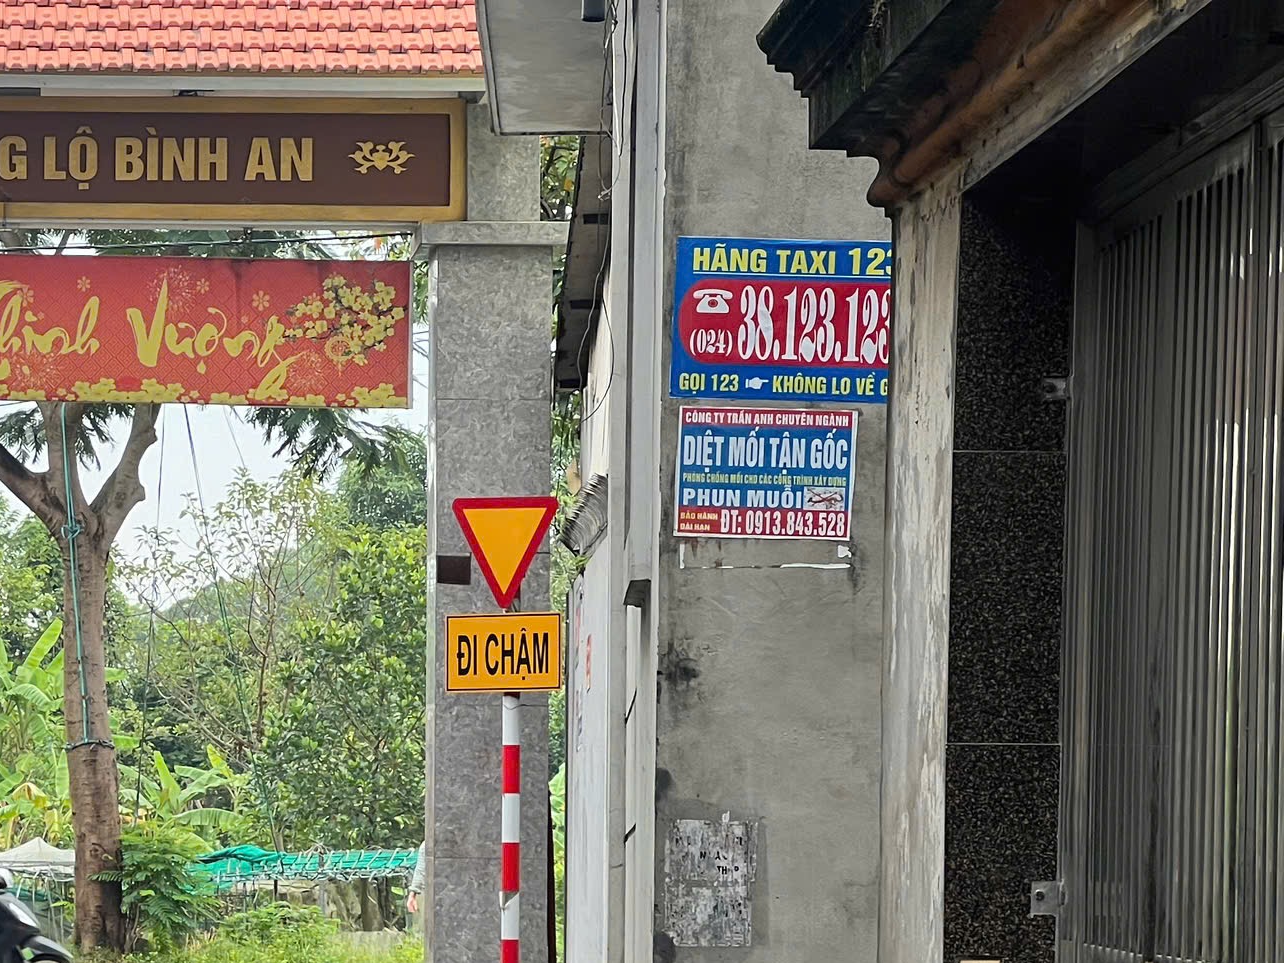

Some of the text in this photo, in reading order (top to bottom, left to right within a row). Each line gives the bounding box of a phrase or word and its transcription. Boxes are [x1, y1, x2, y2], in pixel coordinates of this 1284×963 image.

[43, 126, 98, 190] LỘ
[115, 127, 228, 181] BÌNH
[244, 137, 313, 181] AN
[692, 243, 767, 273] HÃNG
[776, 249, 836, 275] TAXI
[126, 278, 306, 400] Vượng
[689, 328, 733, 357] (024)
[678, 372, 705, 395] GỌI
[711, 373, 739, 392] 123
[772, 372, 827, 395] KHÔNG
[831, 376, 851, 395] LO
[856, 371, 876, 396] VỀ
[685, 409, 712, 423] CÔNG
[714, 412, 725, 424] TY
[753, 413, 774, 425] ANH
[776, 412, 814, 426] CHUYÊN
[815, 412, 849, 427] NGÀNH
[683, 426, 848, 475] DIỆT MỐI TẬN GỐC
[682, 485, 802, 509] PHUN MUỖI
[720, 509, 845, 537] ĐT: 0913.843.528
[456, 627, 549, 681] ĐI CHẬM
